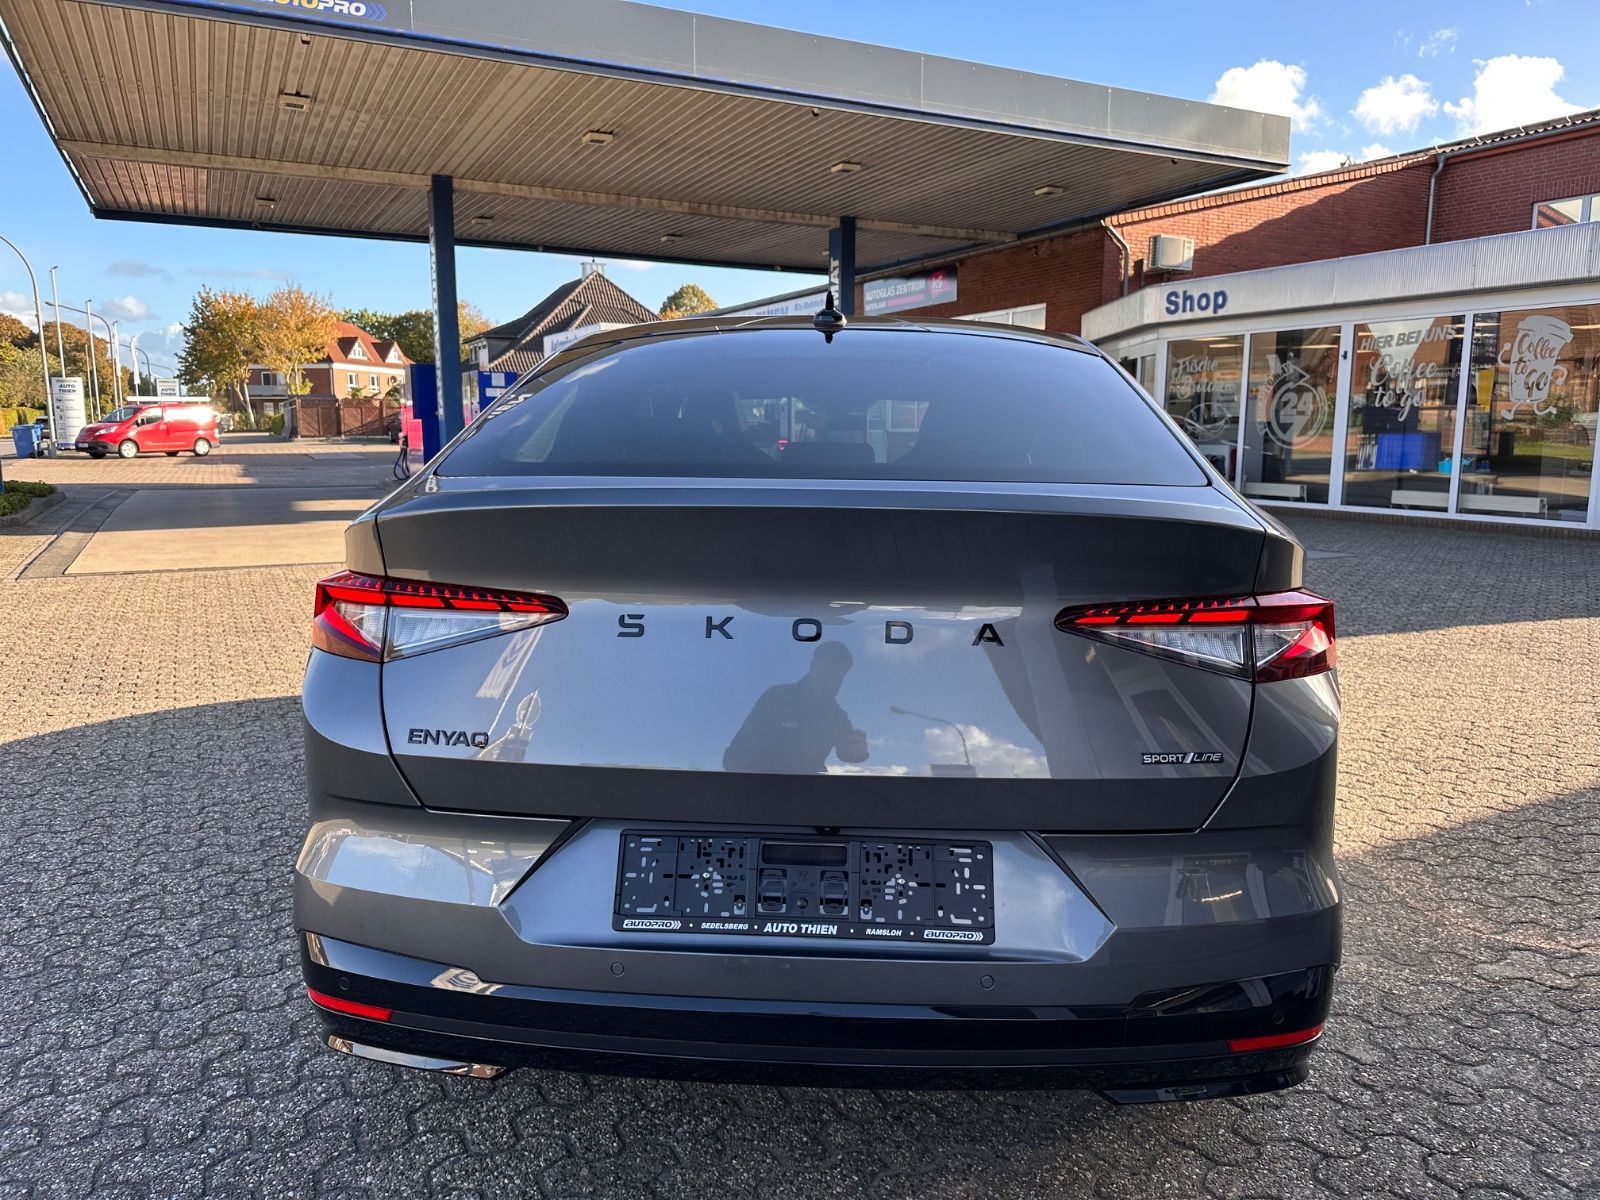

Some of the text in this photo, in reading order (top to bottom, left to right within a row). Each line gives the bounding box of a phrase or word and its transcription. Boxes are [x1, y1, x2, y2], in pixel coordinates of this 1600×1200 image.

[865, 286, 895, 301] AUTOGLAS
[896, 280, 926, 295] ZENTRUM
[1165, 289, 1228, 315] Shop
[1360, 325, 1457, 351] HIER BEI UNS
[1517, 332, 1557, 360] Coffee
[1172, 353, 1217, 379] Frische
[1369, 353, 1438, 394] Coffee
[1514, 355, 1529, 376] to
[1374, 386, 1427, 421] to go
[408, 728, 489, 749] ENYAQ
[701, 922, 749, 930] SEDELSBERG
[763, 922, 798, 933] AUTO
[800, 924, 838, 935] THIEN
[865, 928, 902, 936] RAMSLOH
